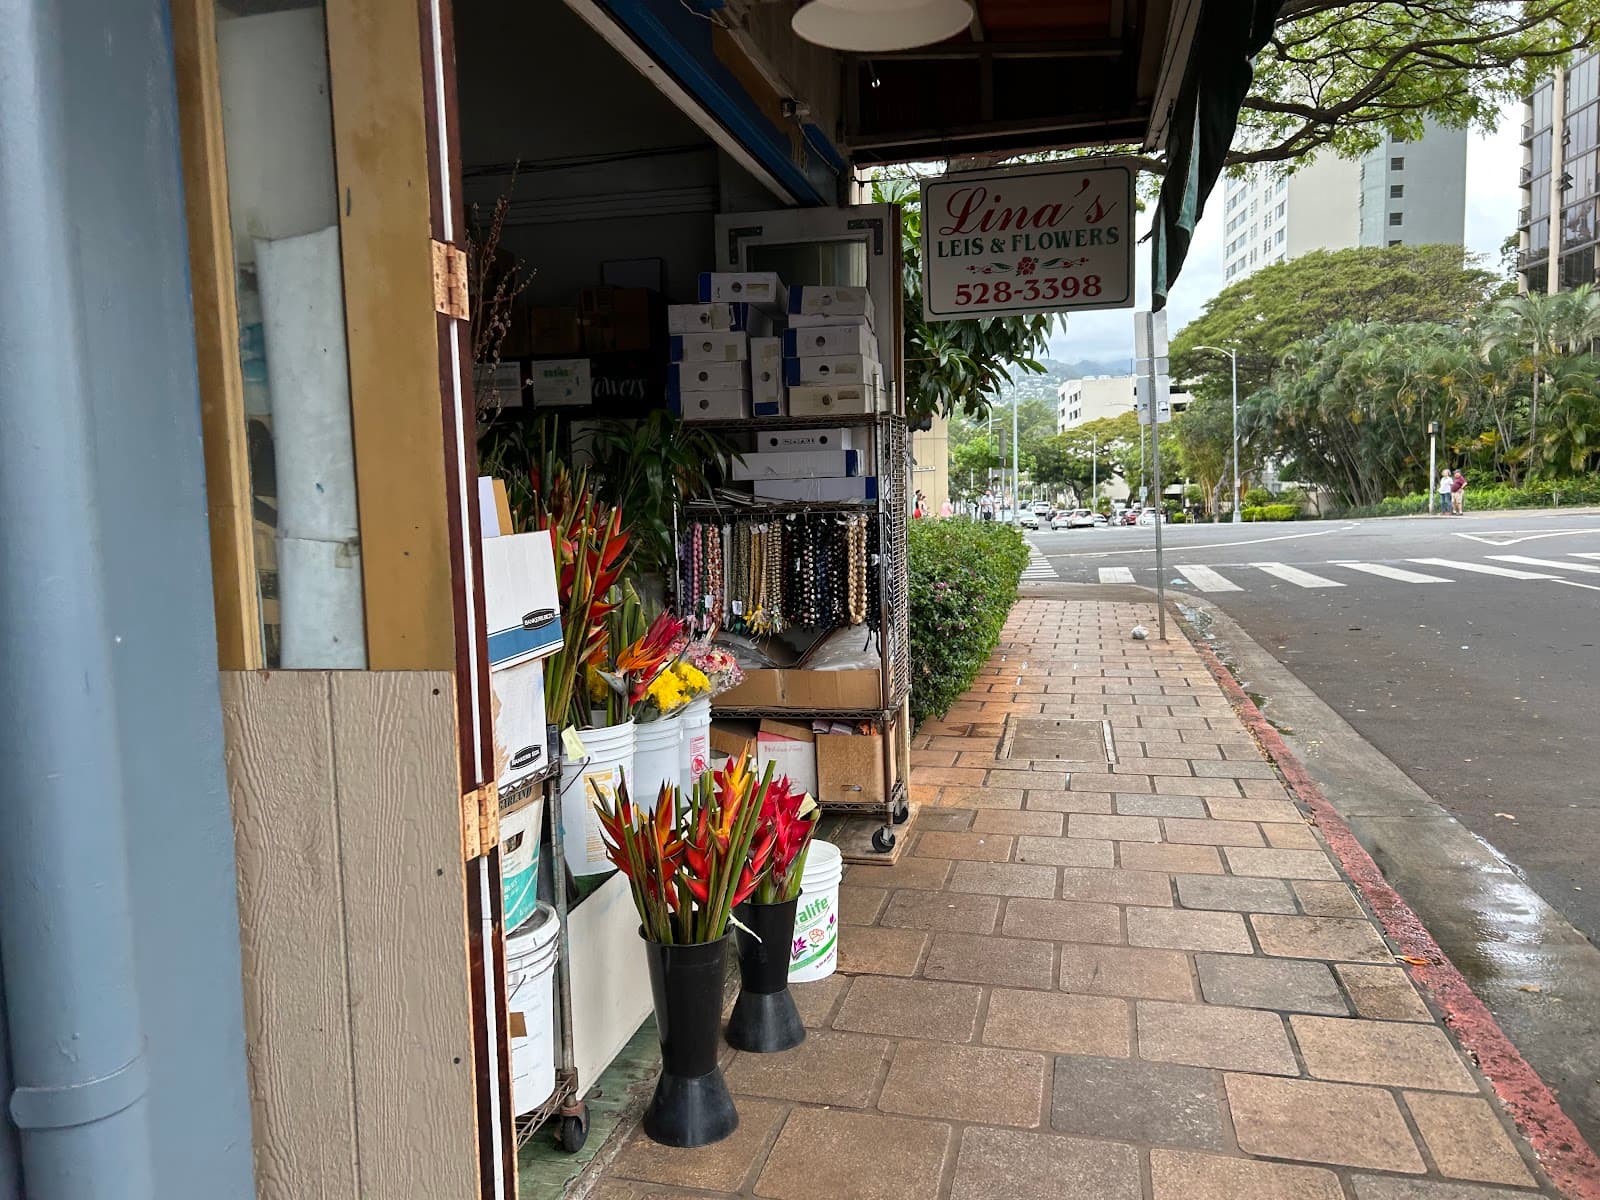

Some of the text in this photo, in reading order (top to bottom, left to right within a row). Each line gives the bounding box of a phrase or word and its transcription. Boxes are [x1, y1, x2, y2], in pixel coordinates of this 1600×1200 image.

[939, 178, 1118, 236] Lina's
[937, 226, 1120, 258] LEIS & FLOWERS
[954, 275, 1102, 306] 528-3398
